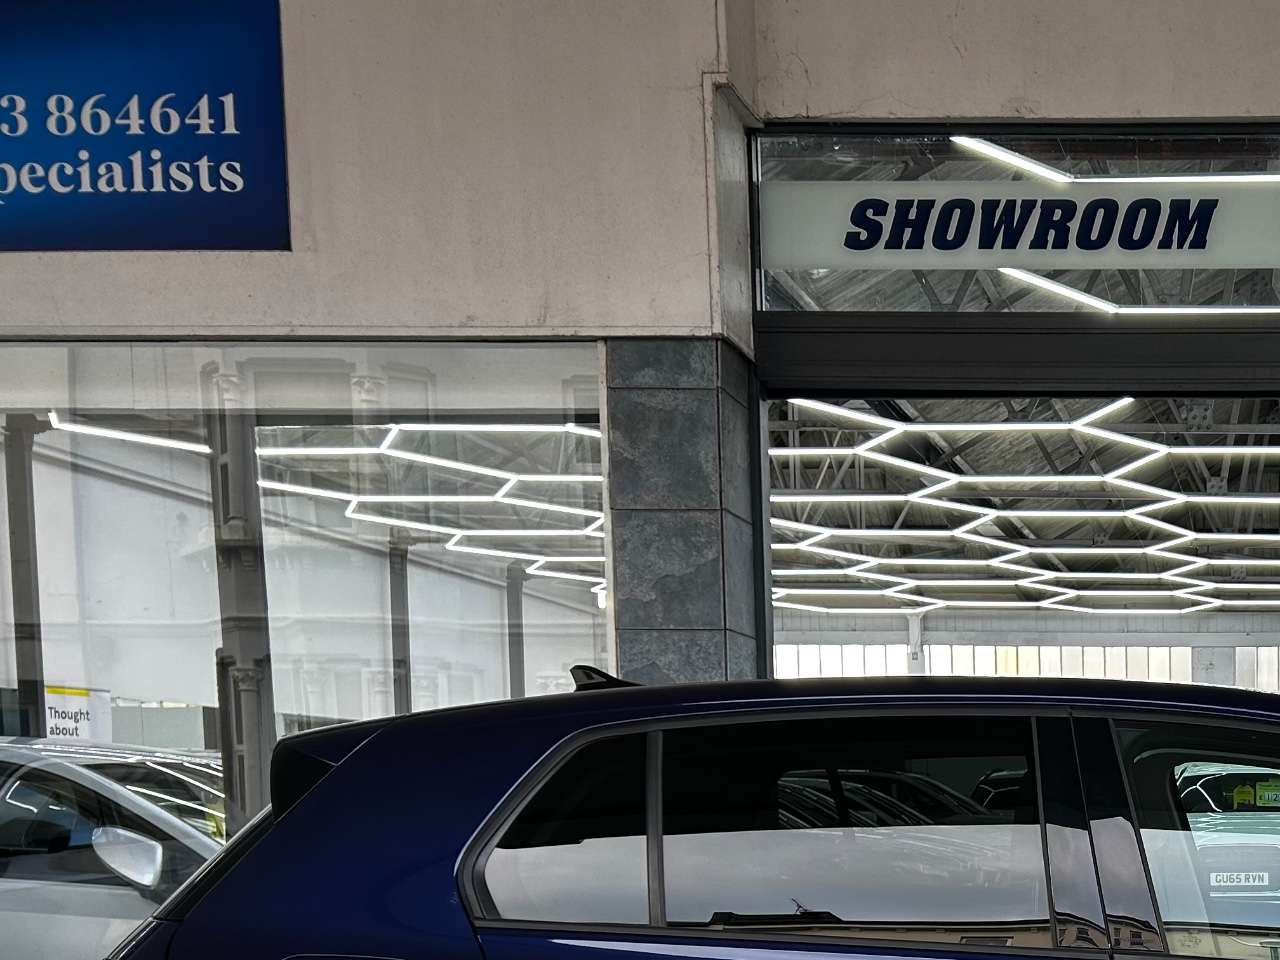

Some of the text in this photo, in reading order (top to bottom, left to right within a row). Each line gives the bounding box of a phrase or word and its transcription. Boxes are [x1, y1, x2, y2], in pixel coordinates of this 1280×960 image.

[0, 92, 241, 136] 3 864641
[843, 198, 1219, 250] SHOWROOM
[48, 706, 91, 724] Thought
[49, 723, 80, 737] about
[1215, 873, 1265, 884] GU65 RVN
